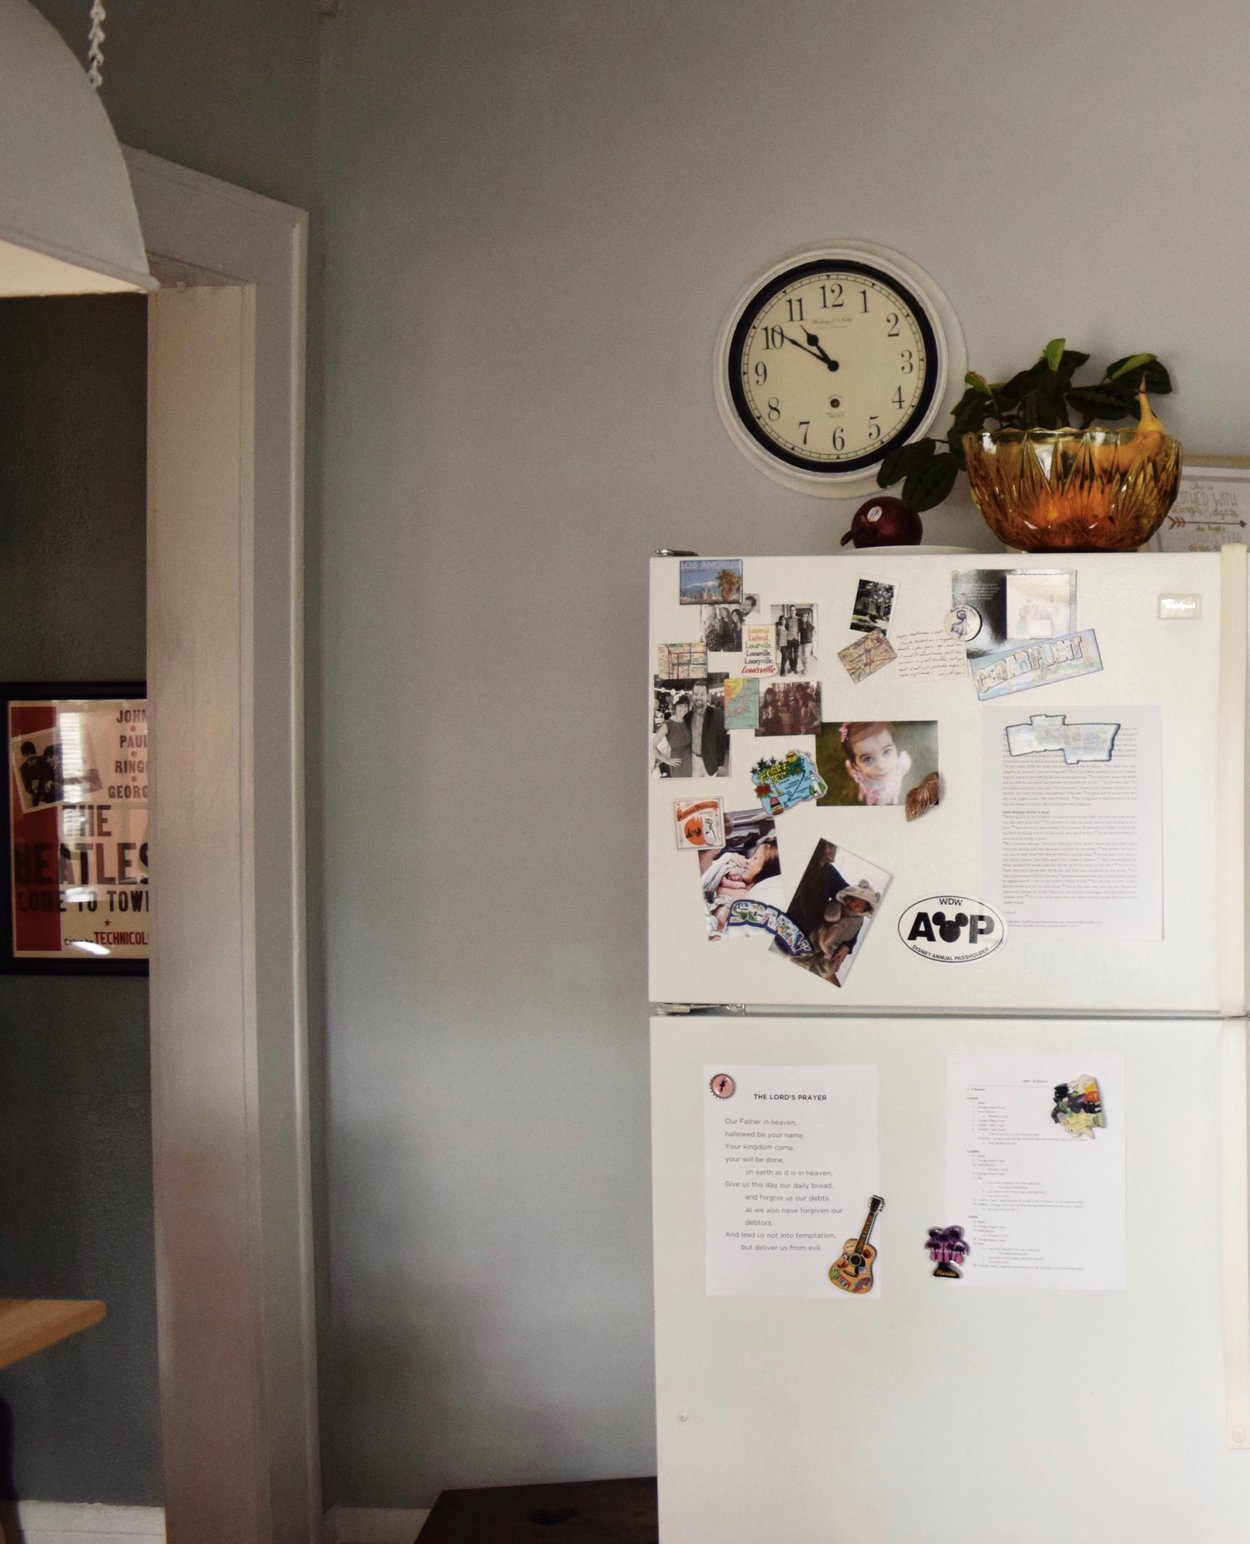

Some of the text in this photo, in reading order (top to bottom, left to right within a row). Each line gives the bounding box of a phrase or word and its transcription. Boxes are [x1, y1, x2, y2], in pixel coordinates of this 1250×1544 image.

[820, 283, 844, 309] 12
[859, 289, 870, 313] 1
[786, 298, 805, 322] 11
[886, 312, 900, 337] 2
[762, 324, 785, 350] 10
[754, 362, 768, 386] 9
[900, 349, 914, 375] 3
[768, 397, 781, 422] 8
[892, 386, 905, 410] 4
[799, 421, 811, 445] 7
[832, 426, 845, 451] 6
[868, 416, 881, 440] 5
[741, 664, 776, 674] Louisville
[115, 760, 148, 774] RING
[62, 804, 112, 836] THE
[107, 890, 149, 912] TOW
[939, 898, 963, 906] WDW
[912, 944, 989, 961] DISNEY ANNUAL PASSHOLDER
[769, 1093, 796, 1101] LORD'S
[743, 1143, 772, 1151] kingdom
[725, 1180, 741, 1188] Give
[765, 1181, 778, 1190] day
[792, 1182, 810, 1190] daily
[759, 1194, 784, 1202] forgive
[800, 1207, 830, 1215] forgiven
